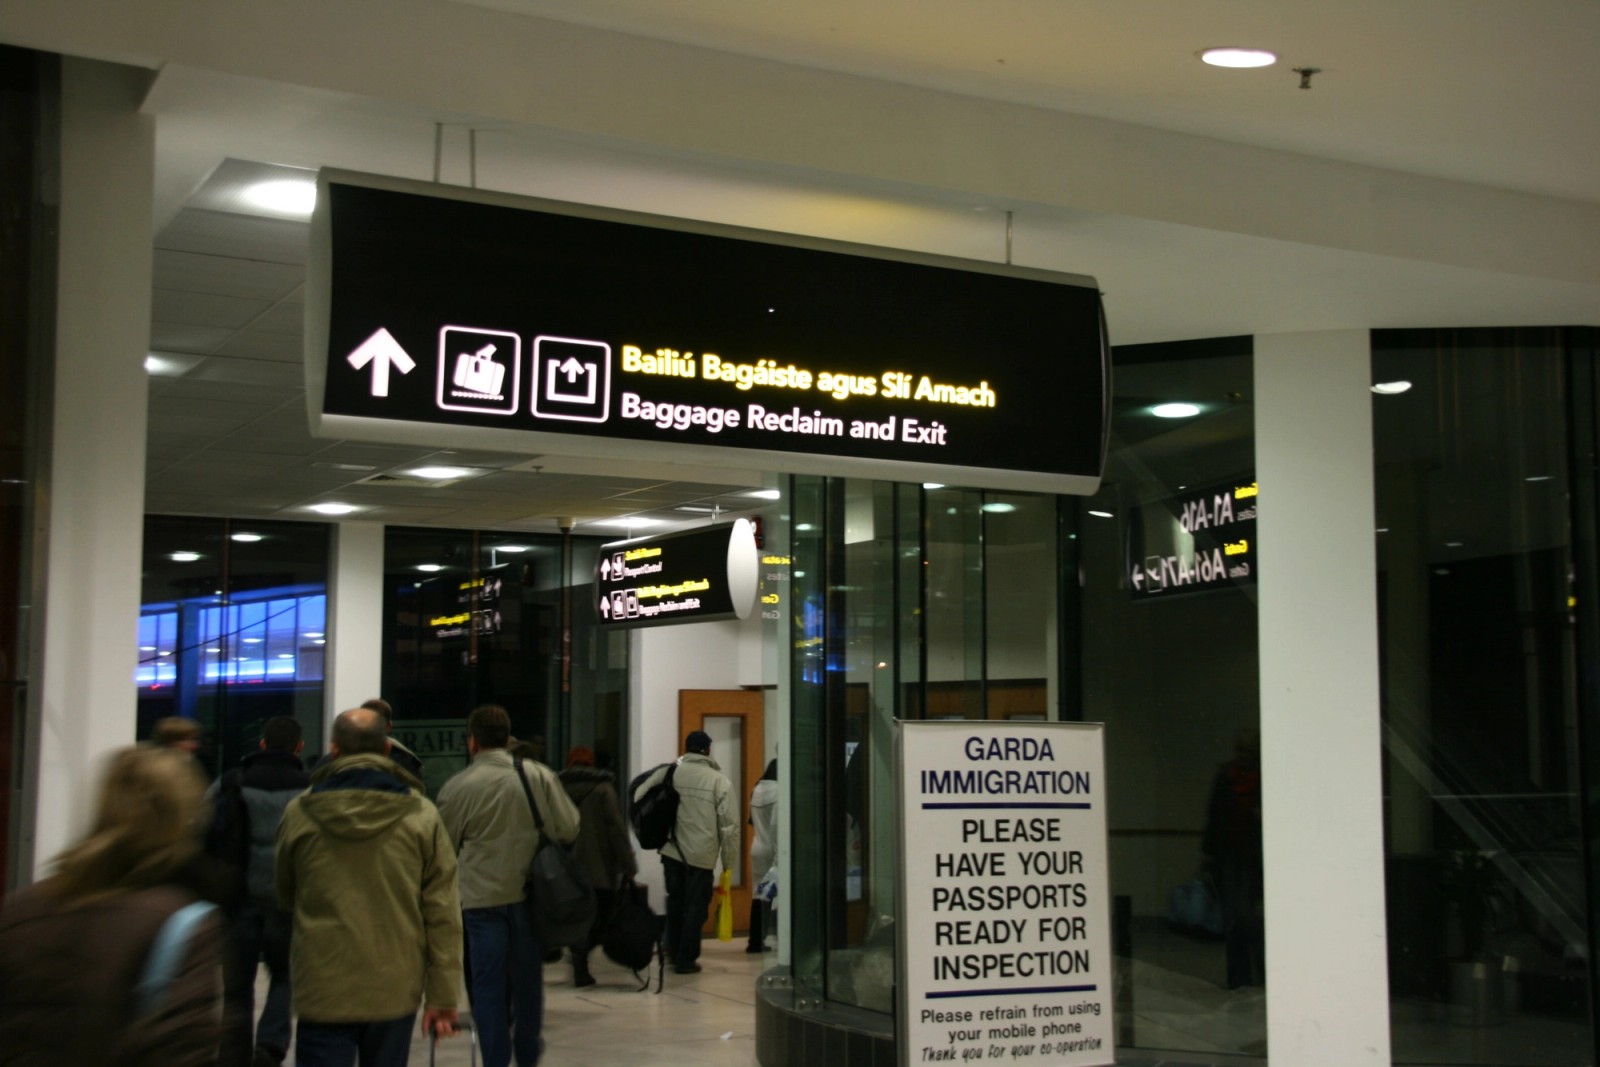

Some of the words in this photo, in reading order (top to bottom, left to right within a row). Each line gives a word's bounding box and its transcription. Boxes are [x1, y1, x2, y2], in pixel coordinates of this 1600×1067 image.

[621, 344, 696, 379] Bailiú
[701, 352, 814, 391] Bagáiste
[816, 371, 878, 401] agus
[880, 370, 913, 400] Slí
[913, 375, 997, 408] Amach
[621, 392, 741, 433] Baggage
[747, 403, 844, 437] Reclaim
[849, 415, 897, 441] and
[901, 418, 948, 446] Exit
[964, 736, 1055, 762] GARDA
[921, 769, 1091, 795] IMMIGRATION
[962, 817, 1061, 844] PLEASE
[935, 851, 1006, 878] HAVE
[1017, 850, 1084, 877] YOUR
[932, 882, 1087, 912] PASSPORTS
[935, 918, 1027, 946] READY
[1038, 916, 1087, 943] FOR
[933, 949, 1090, 981] INSPECTION
[921, 1009, 973, 1023] Please
[979, 1006, 1027, 1021] refrain
[1032, 1004, 1064, 1018] from
[1068, 1001, 1101, 1017] using
[948, 1030, 981, 1044] your
[988, 1024, 1036, 1041] mobile
[1042, 1022, 1082, 1038] phone
[921, 1046, 957, 1062] Thank
[962, 1048, 983, 1063] you
[986, 1045, 1006, 1058] for
[1010, 1046, 1036, 1061] your
[1039, 1037, 1103, 1056] co-operation
